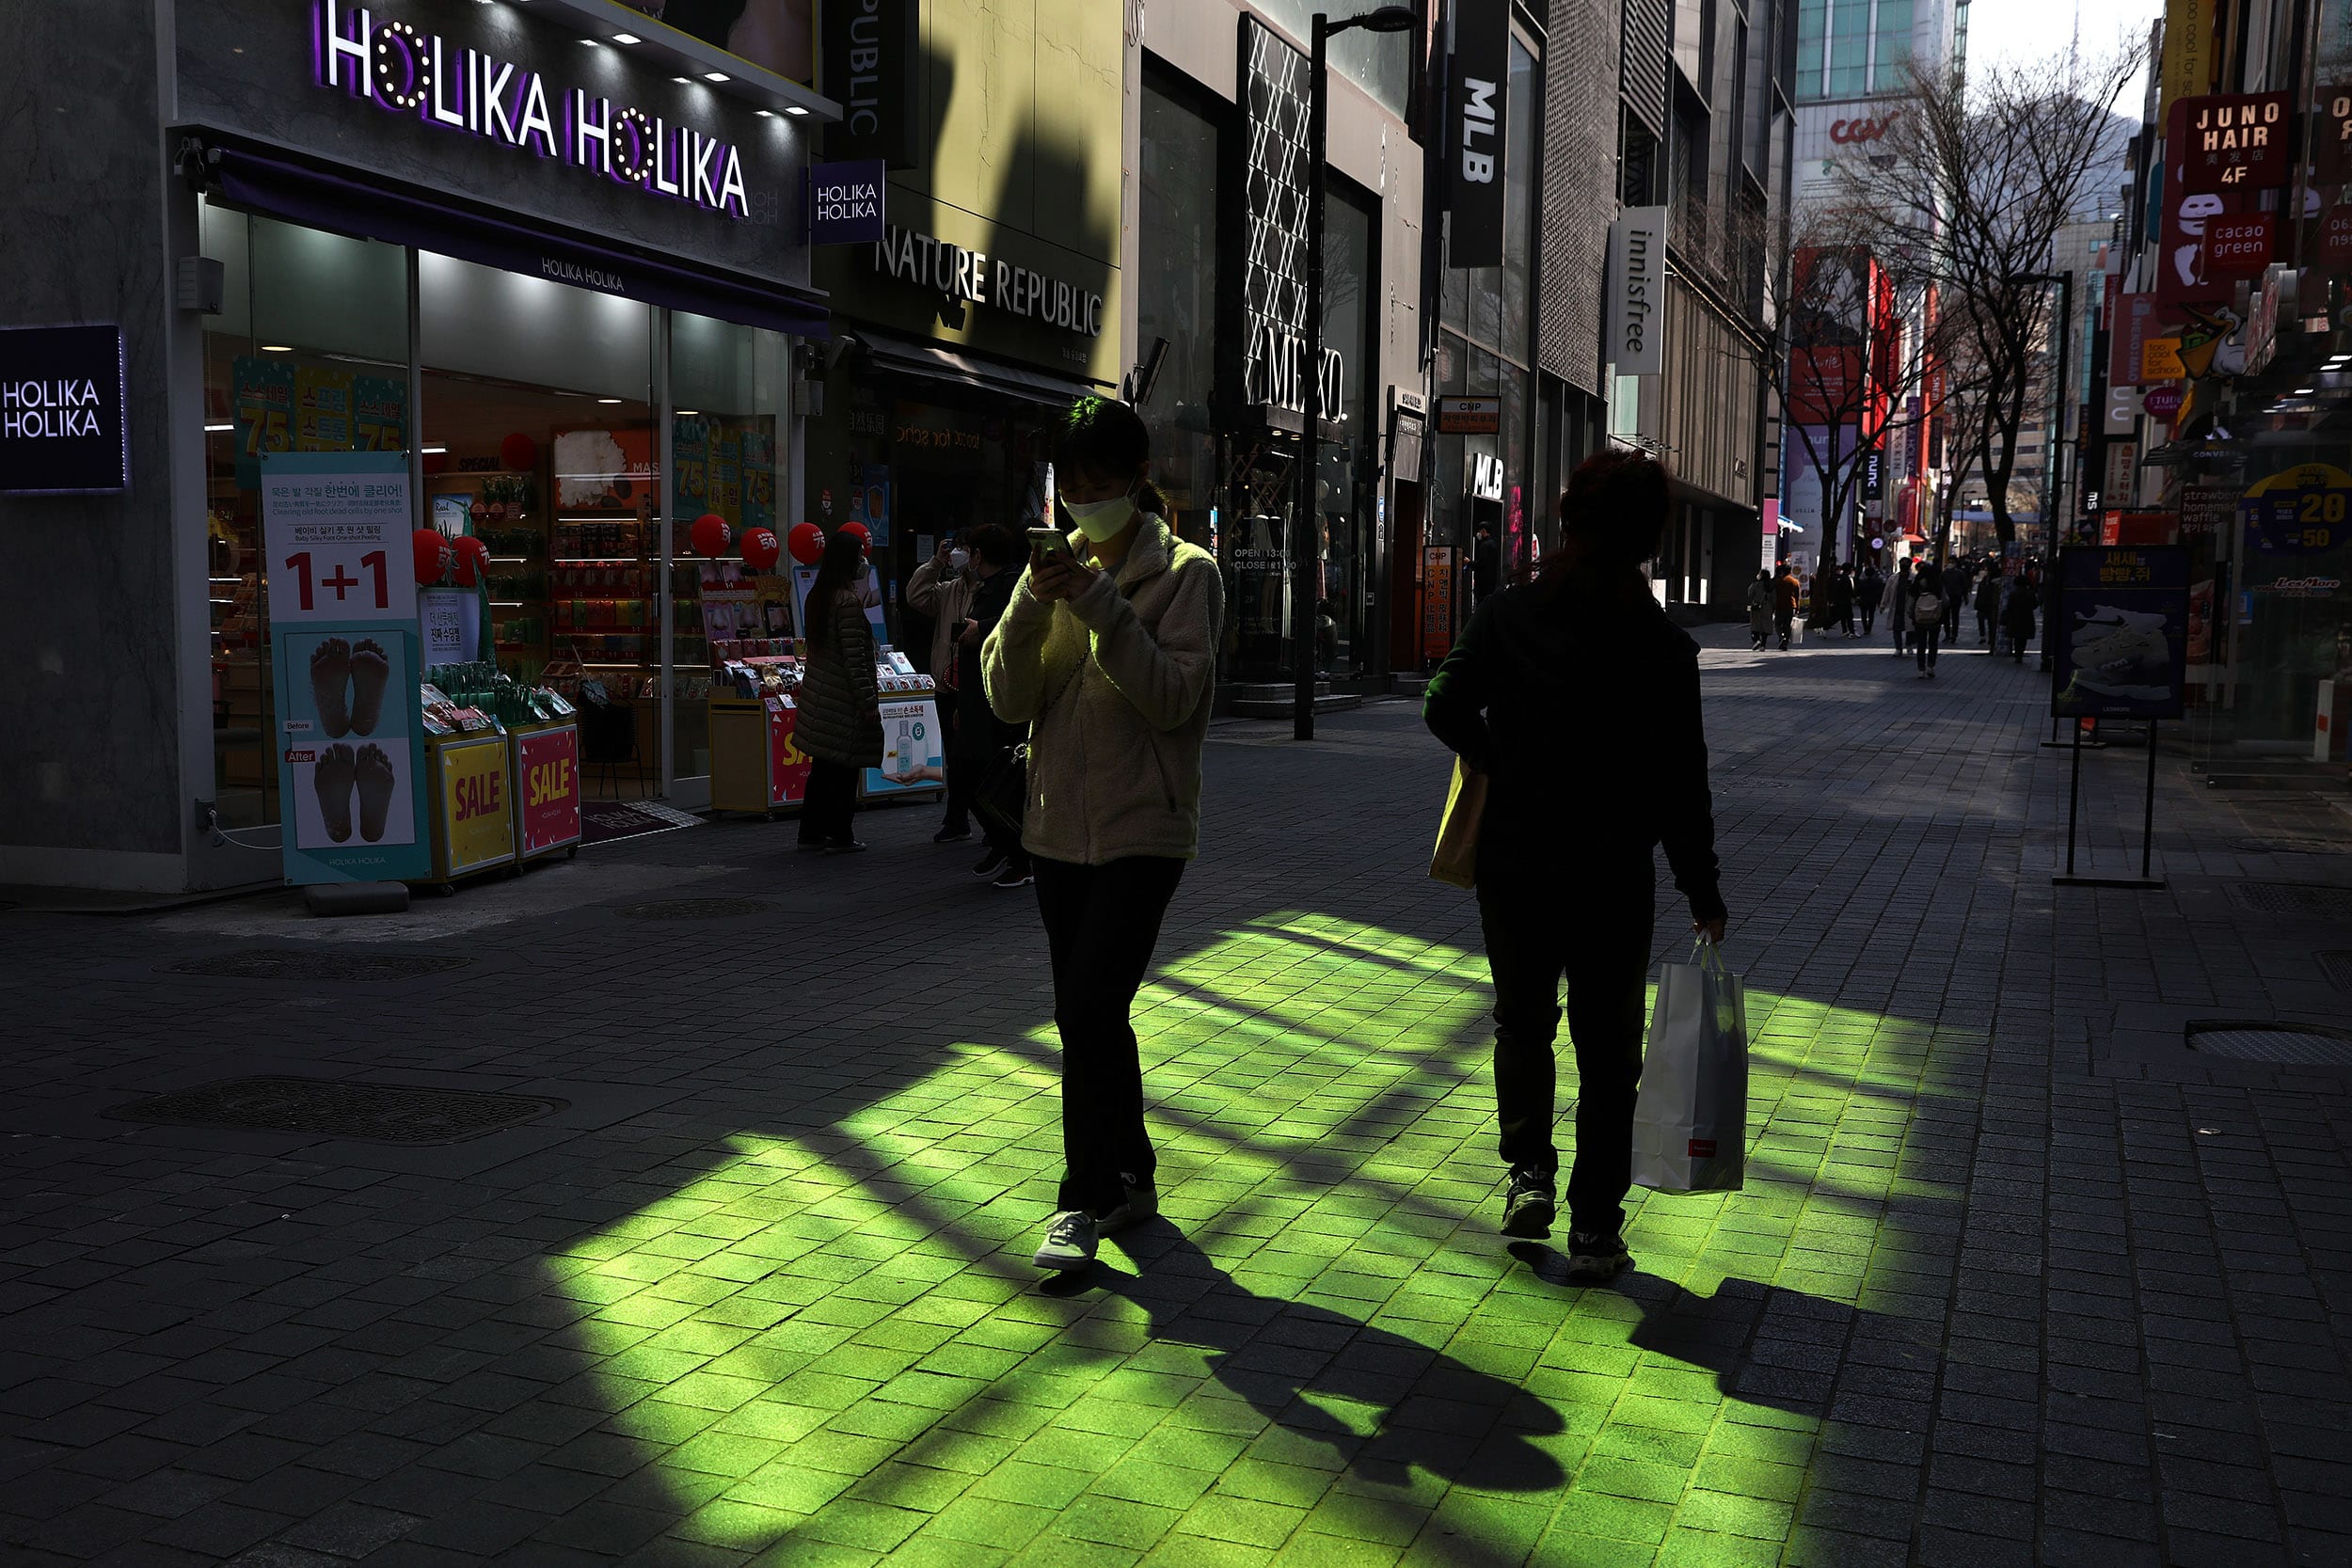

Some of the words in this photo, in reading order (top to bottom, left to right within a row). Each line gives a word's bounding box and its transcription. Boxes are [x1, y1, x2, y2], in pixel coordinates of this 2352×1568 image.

[2185, 24, 2198, 54] cool
[2185, 57, 2198, 76] for
[326, 0, 558, 157] HOLIKA
[576, 88, 750, 218] HOLIKA
[2196, 102, 2280, 130] JUNO
[1463, 77, 1497, 184] MLB
[1830, 111, 1899, 144] CGV
[2202, 126, 2269, 151] HAIR
[2220, 166, 2249, 184] 4F
[818, 183, 877, 203] HOLIKA
[818, 201, 877, 221] HOLIKA
[2215, 225, 2265, 239] cacao
[2215, 241, 2264, 258] green
[542, 257, 583, 282] HOLIKA
[585, 267, 625, 293] HOLIKA
[875, 225, 986, 304] NATURE
[995, 259, 1103, 338] REPUBLIC
[1627, 230, 1652, 354] innisfree
[2148, 358, 2162, 367] for
[2149, 349, 2170, 357] cool
[2147, 365, 2183, 374] school
[3, 378, 101, 408] HOLIKA
[1459, 403, 1481, 411] CNP
[5, 408, 102, 438] HOLIKA
[240, 406, 292, 457] 75
[458, 457, 501, 471] SPECIAL
[1867, 454, 1879, 488] nunc
[676, 459, 706, 498] 75
[1473, 451, 1505, 500] MLB
[325, 483, 359, 498] 한번에
[363, 483, 403, 498] 클리어!
[744, 468, 771, 505] 75
[272, 508, 301, 516] Clearing
[436, 501, 450, 512] Real
[2183, 512, 2220, 522] waffle
[294, 527, 317, 535] 베이비
[337, 526, 345, 534] 풋
[760, 537, 777, 550] 50
[813, 536, 826, 549] 75
[1234, 548, 1261, 558] OPEN
[1429, 552, 1447, 561] CNP
[1234, 561, 1265, 570] CLOSE
[285, 550, 389, 610] 1+1
[2273, 577, 2341, 589] LesMore
[288, 752, 314, 762] After
[529, 758, 571, 807] SALE
[455, 771, 501, 822] SALE
[358, 857, 387, 865] HOLIKA
